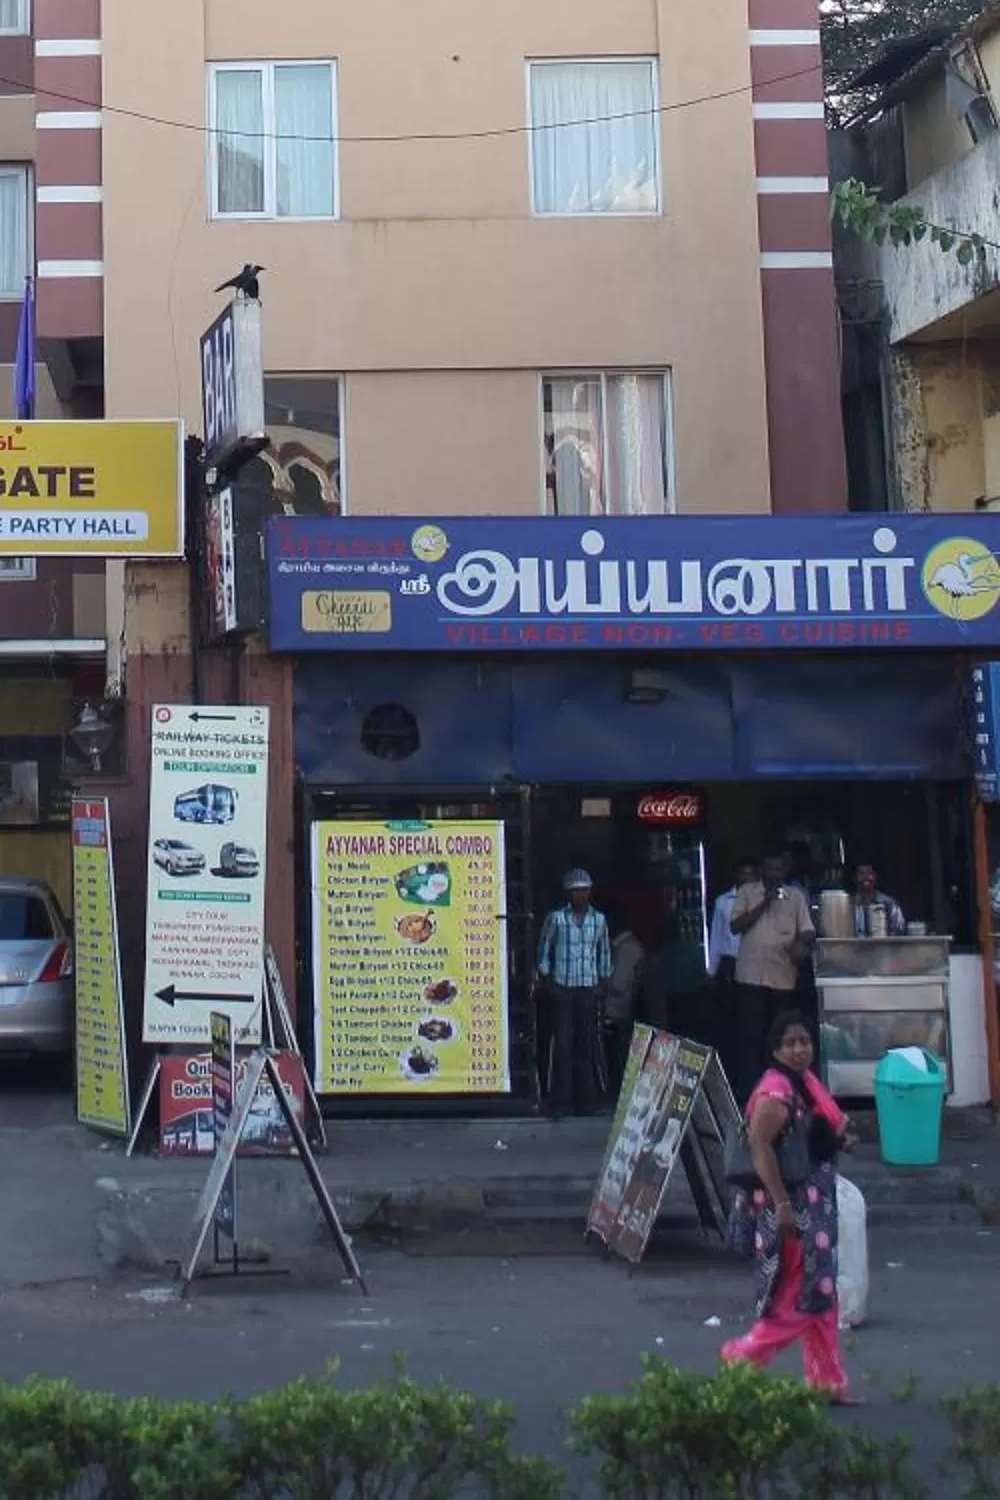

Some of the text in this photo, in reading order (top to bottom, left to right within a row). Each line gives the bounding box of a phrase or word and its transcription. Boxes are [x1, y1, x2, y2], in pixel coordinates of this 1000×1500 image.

[203, 316, 236, 451] BAR
[9, 518, 73, 534] PARTY
[83, 518, 137, 535] HALL
[437, 527, 915, 616] அய்யனார்
[446, 624, 590, 644] VILLAGE
[778, 620, 912, 641] CUISINE
[327, 836, 493, 855] AYYANAR SPECIAL COMBO
